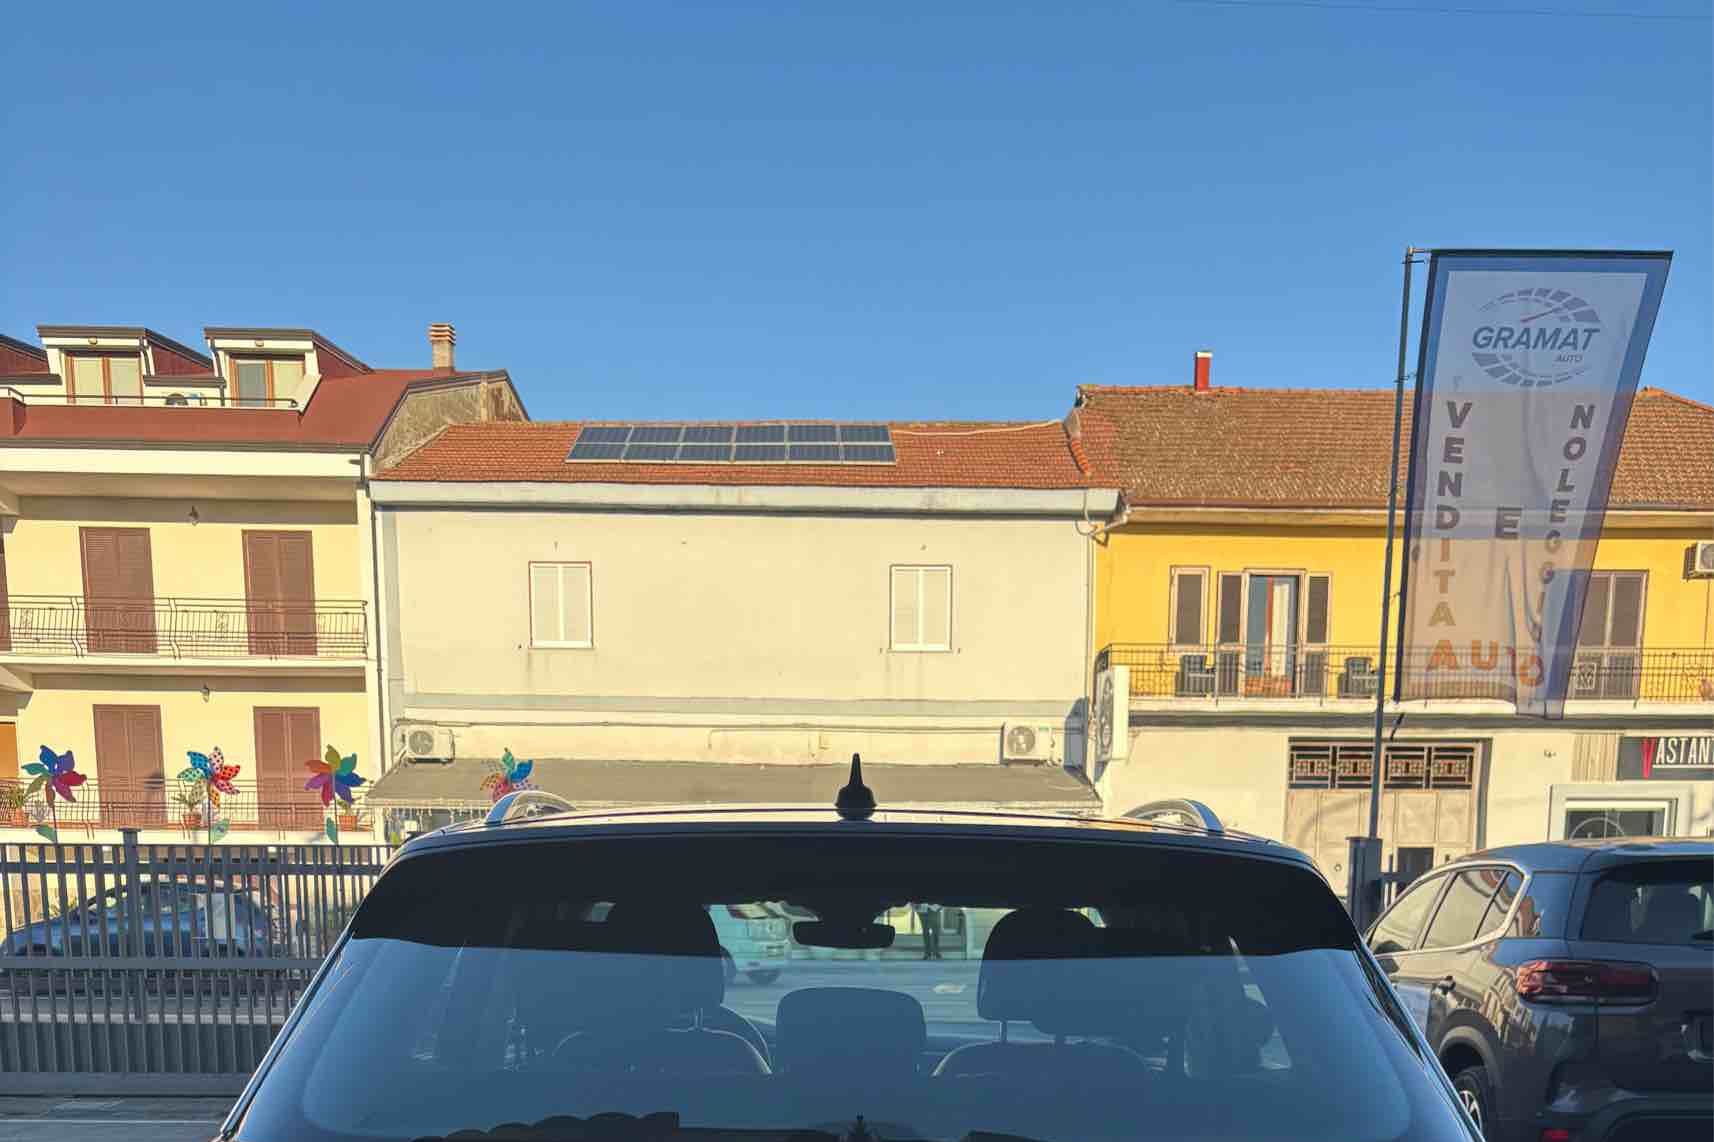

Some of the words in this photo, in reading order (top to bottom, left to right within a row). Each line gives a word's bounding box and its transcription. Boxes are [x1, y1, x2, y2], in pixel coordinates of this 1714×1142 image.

[1472, 326, 1600, 350] GRAMAT
[1555, 353, 1583, 363] AUTO
[1428, 401, 1472, 626] VENDITA
[1495, 507, 1522, 539] E
[1640, 736, 1714, 780] VASTAN
